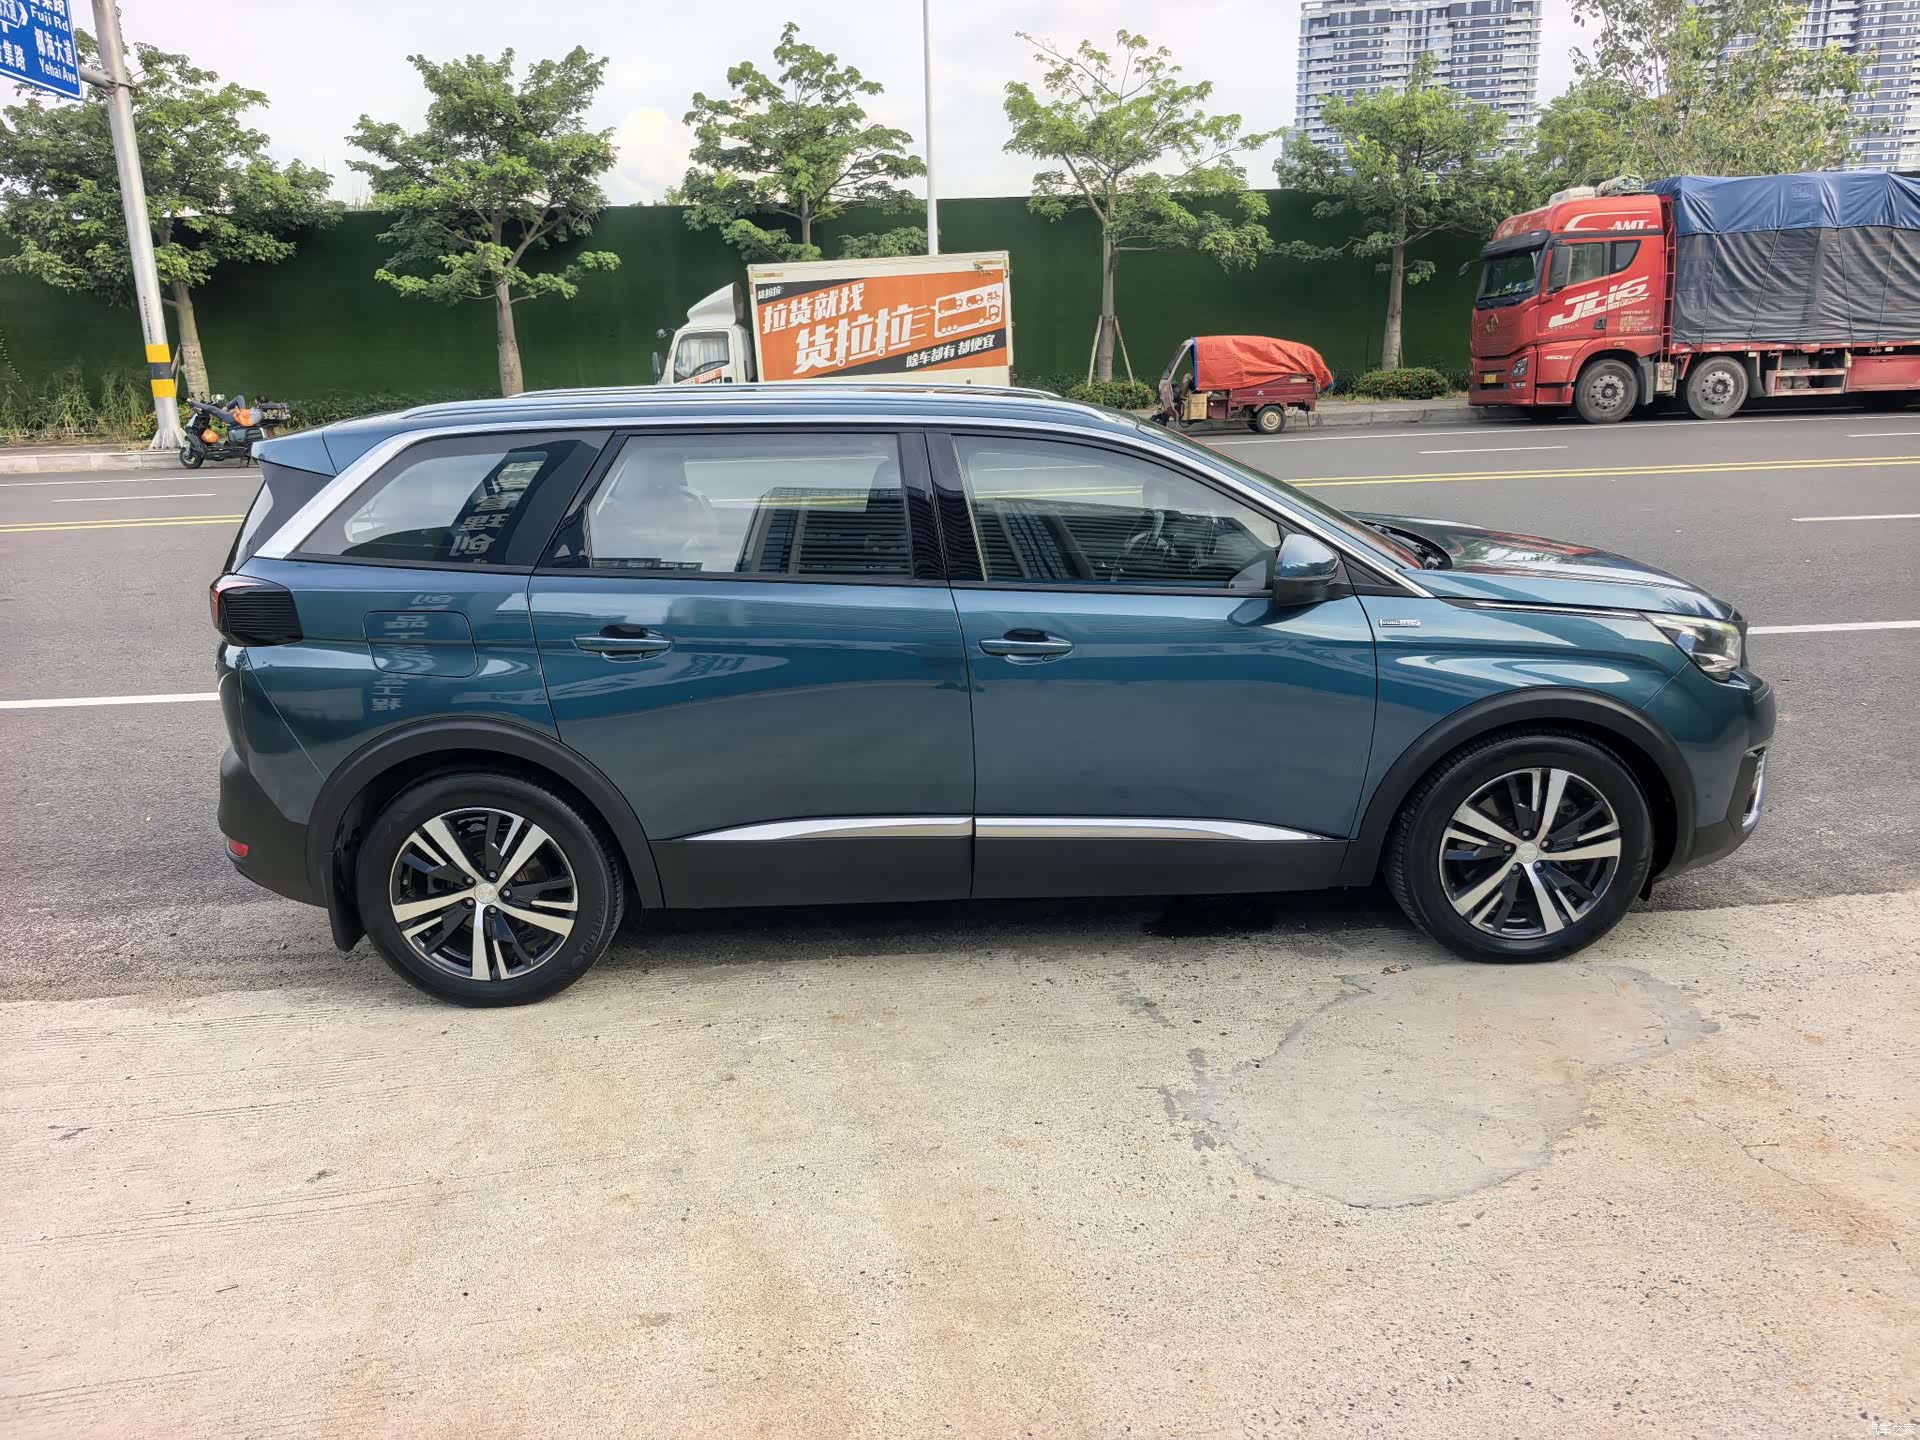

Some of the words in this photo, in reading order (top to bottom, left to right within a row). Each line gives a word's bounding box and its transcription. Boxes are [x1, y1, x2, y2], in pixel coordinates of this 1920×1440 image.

[30, 6, 52, 27] Fuji
[55, 17, 69, 32] Rd
[0, 39, 26, 72] 集路
[38, 56, 62, 80] Yehai
[62, 65, 77, 85] Ave
[1611, 219, 1650, 232] AMT
[762, 282, 865, 335] 拉货就找
[793, 304, 915, 375] 货拉拉
[905, 344, 955, 368] 啥车都有
[957, 334, 996, 356] 都便宜
